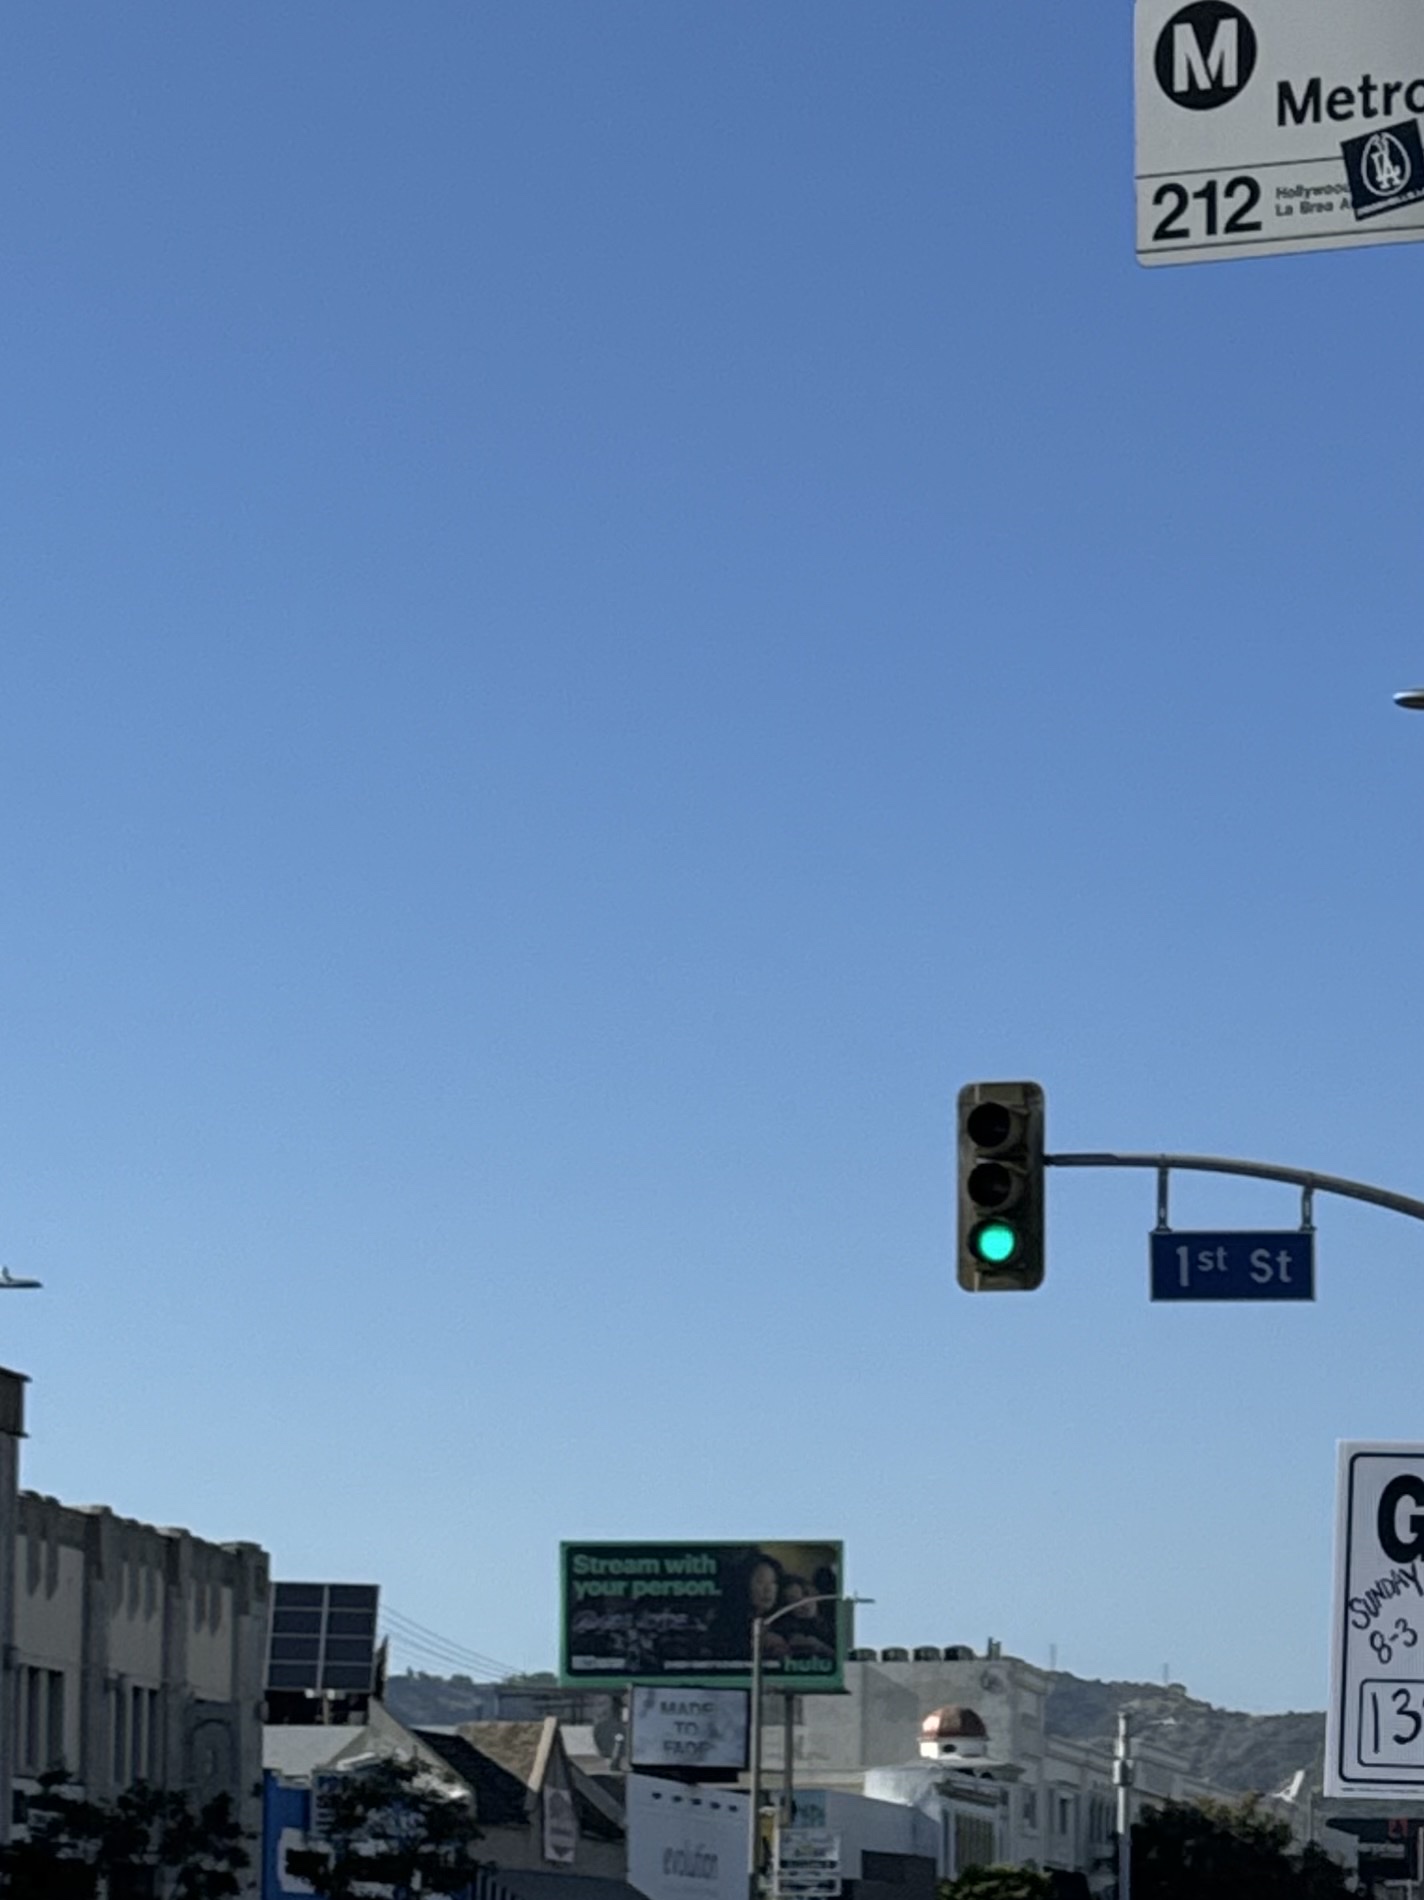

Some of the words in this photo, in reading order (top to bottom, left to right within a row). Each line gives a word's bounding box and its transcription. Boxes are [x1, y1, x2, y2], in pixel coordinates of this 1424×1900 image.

[1152, 176, 1262, 241] 212
[1176, 1245, 1228, 1287] 1st
[1249, 1248, 1293, 1284] St
[572, 1553, 661, 1575] Stream
[664, 1553, 717, 1575] with
[573, 1579, 628, 1599] your
[1348, 1563, 1424, 1630] SUNDAY
[1369, 1618, 1418, 1665] 8-3
[783, 1656, 833, 1672] hulu
